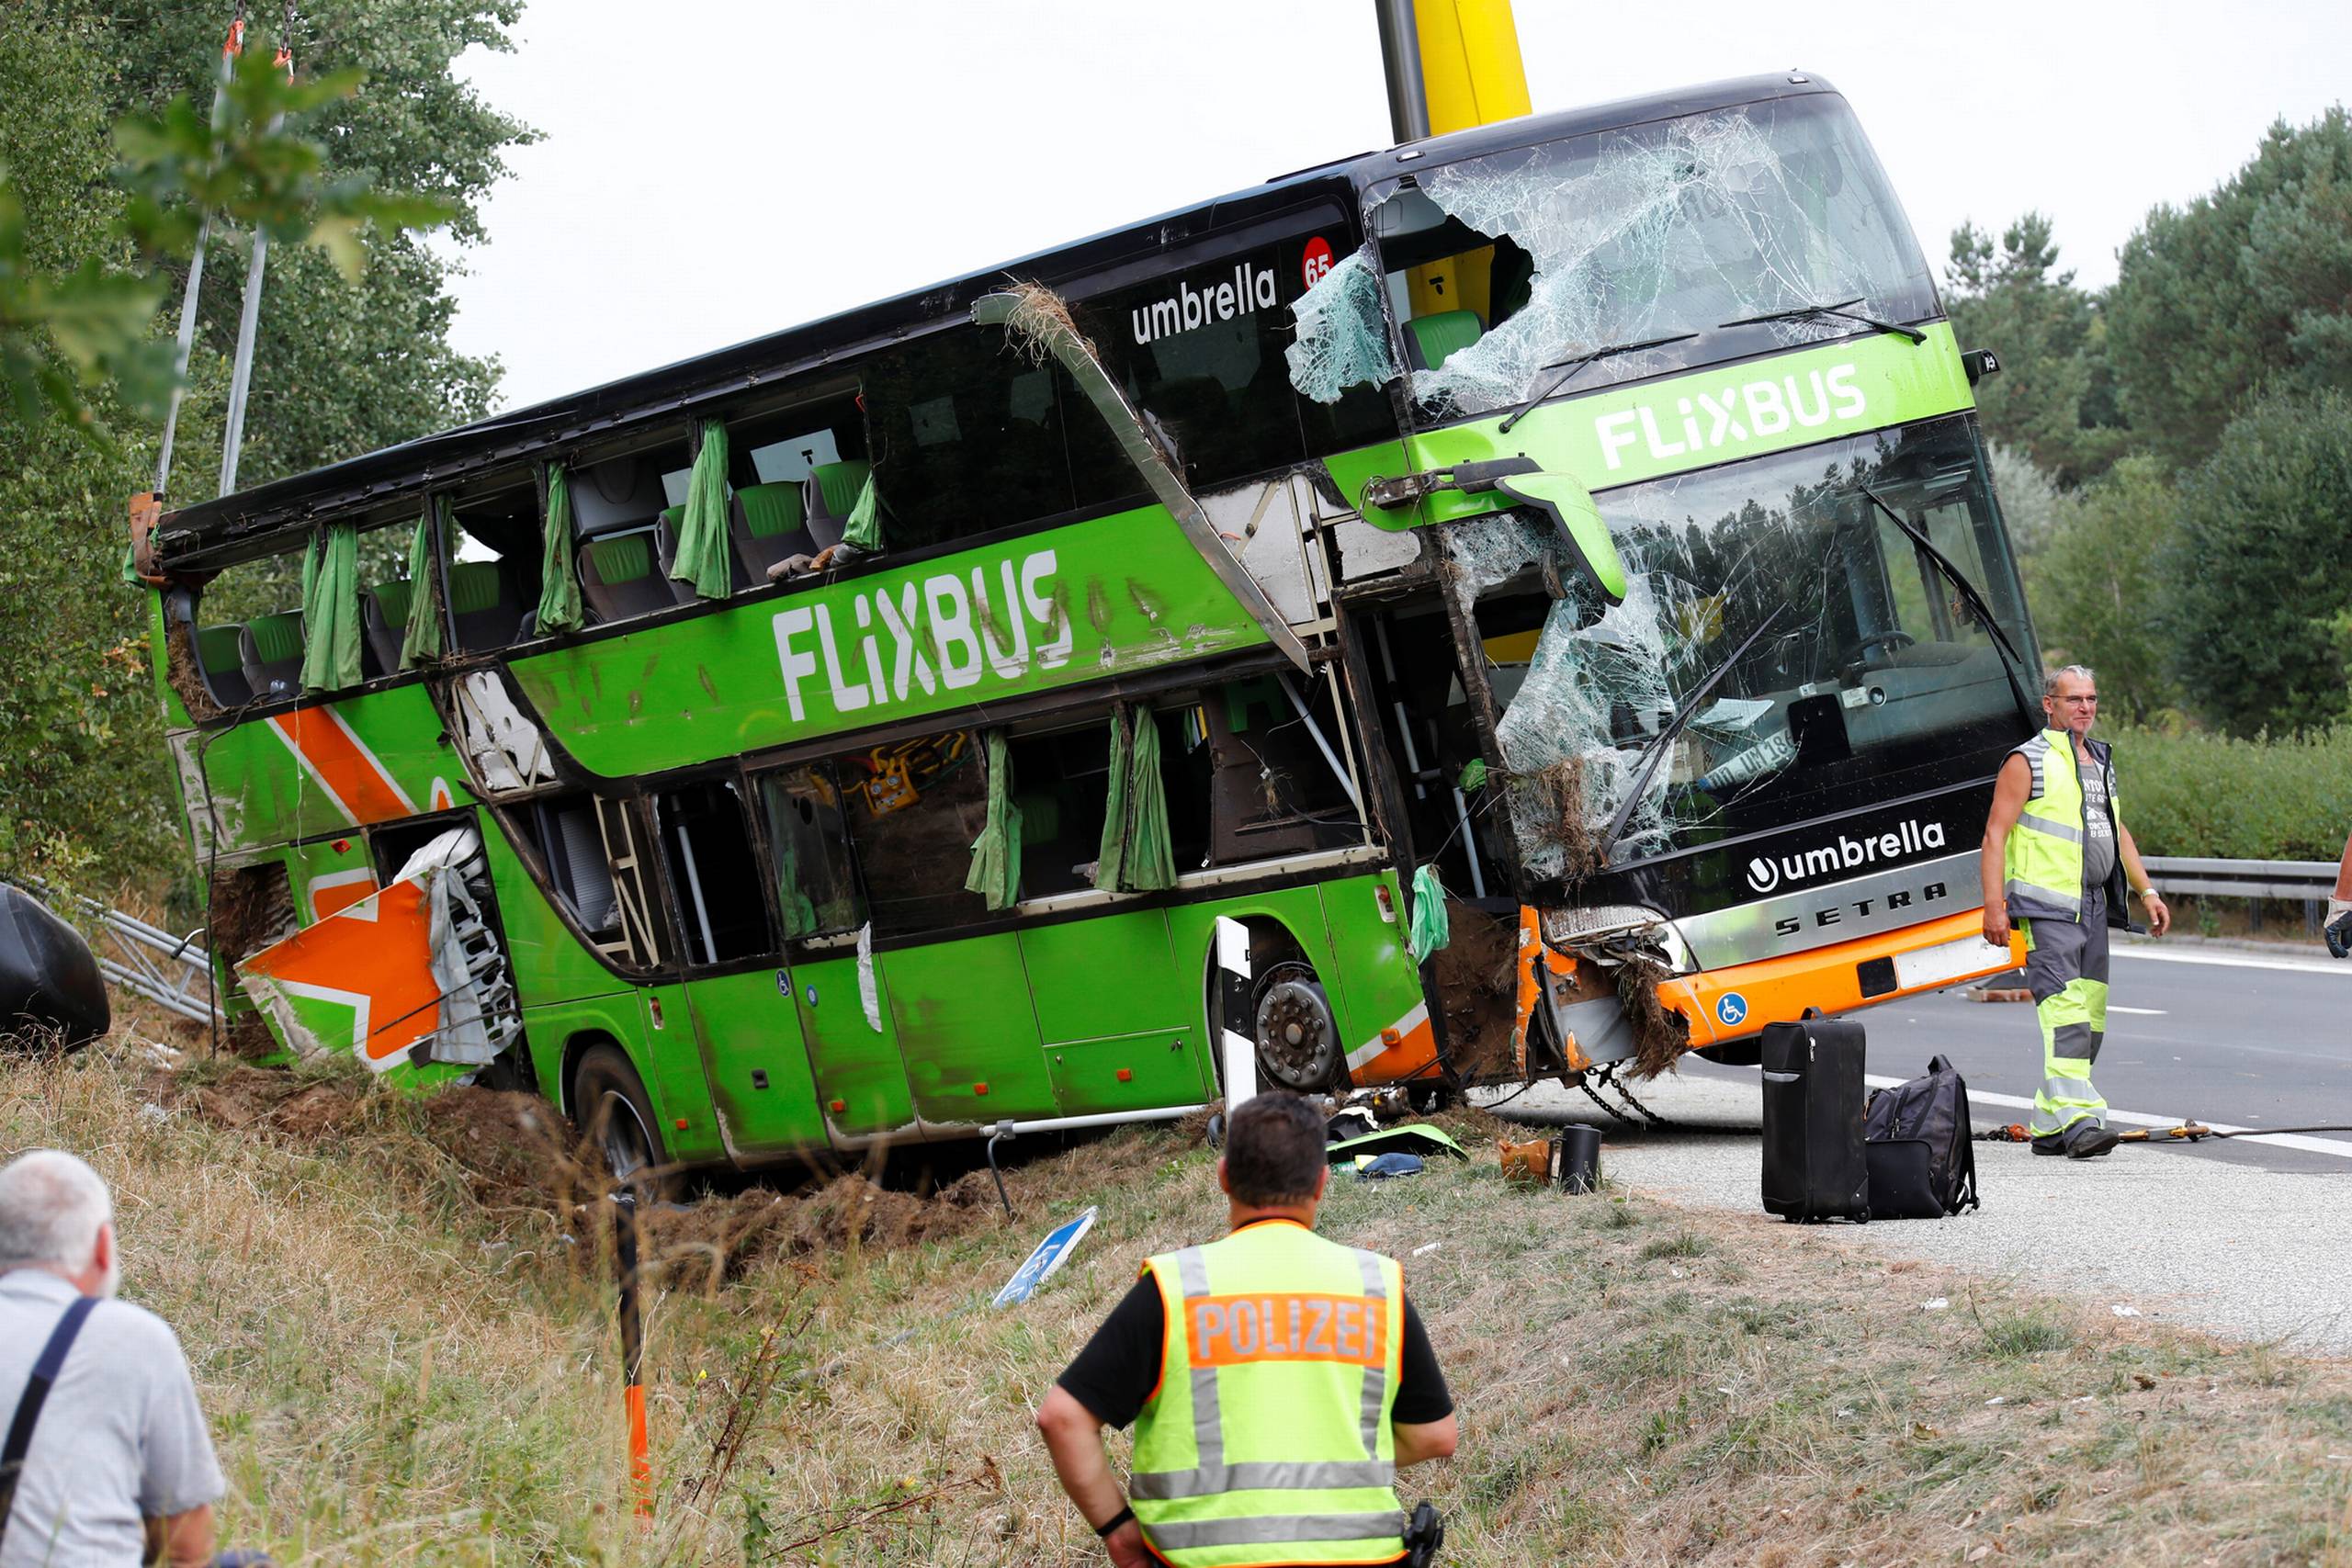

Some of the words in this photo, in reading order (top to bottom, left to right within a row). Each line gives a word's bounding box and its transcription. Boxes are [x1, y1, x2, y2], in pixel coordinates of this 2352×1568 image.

[1306, 254, 1330, 288] 65
[1132, 263, 1277, 344] umbrella
[1785, 819, 1945, 881] umbrella
[1775, 882, 1948, 936] SETRA
[1196, 1300, 1375, 1359] POLIZEI
